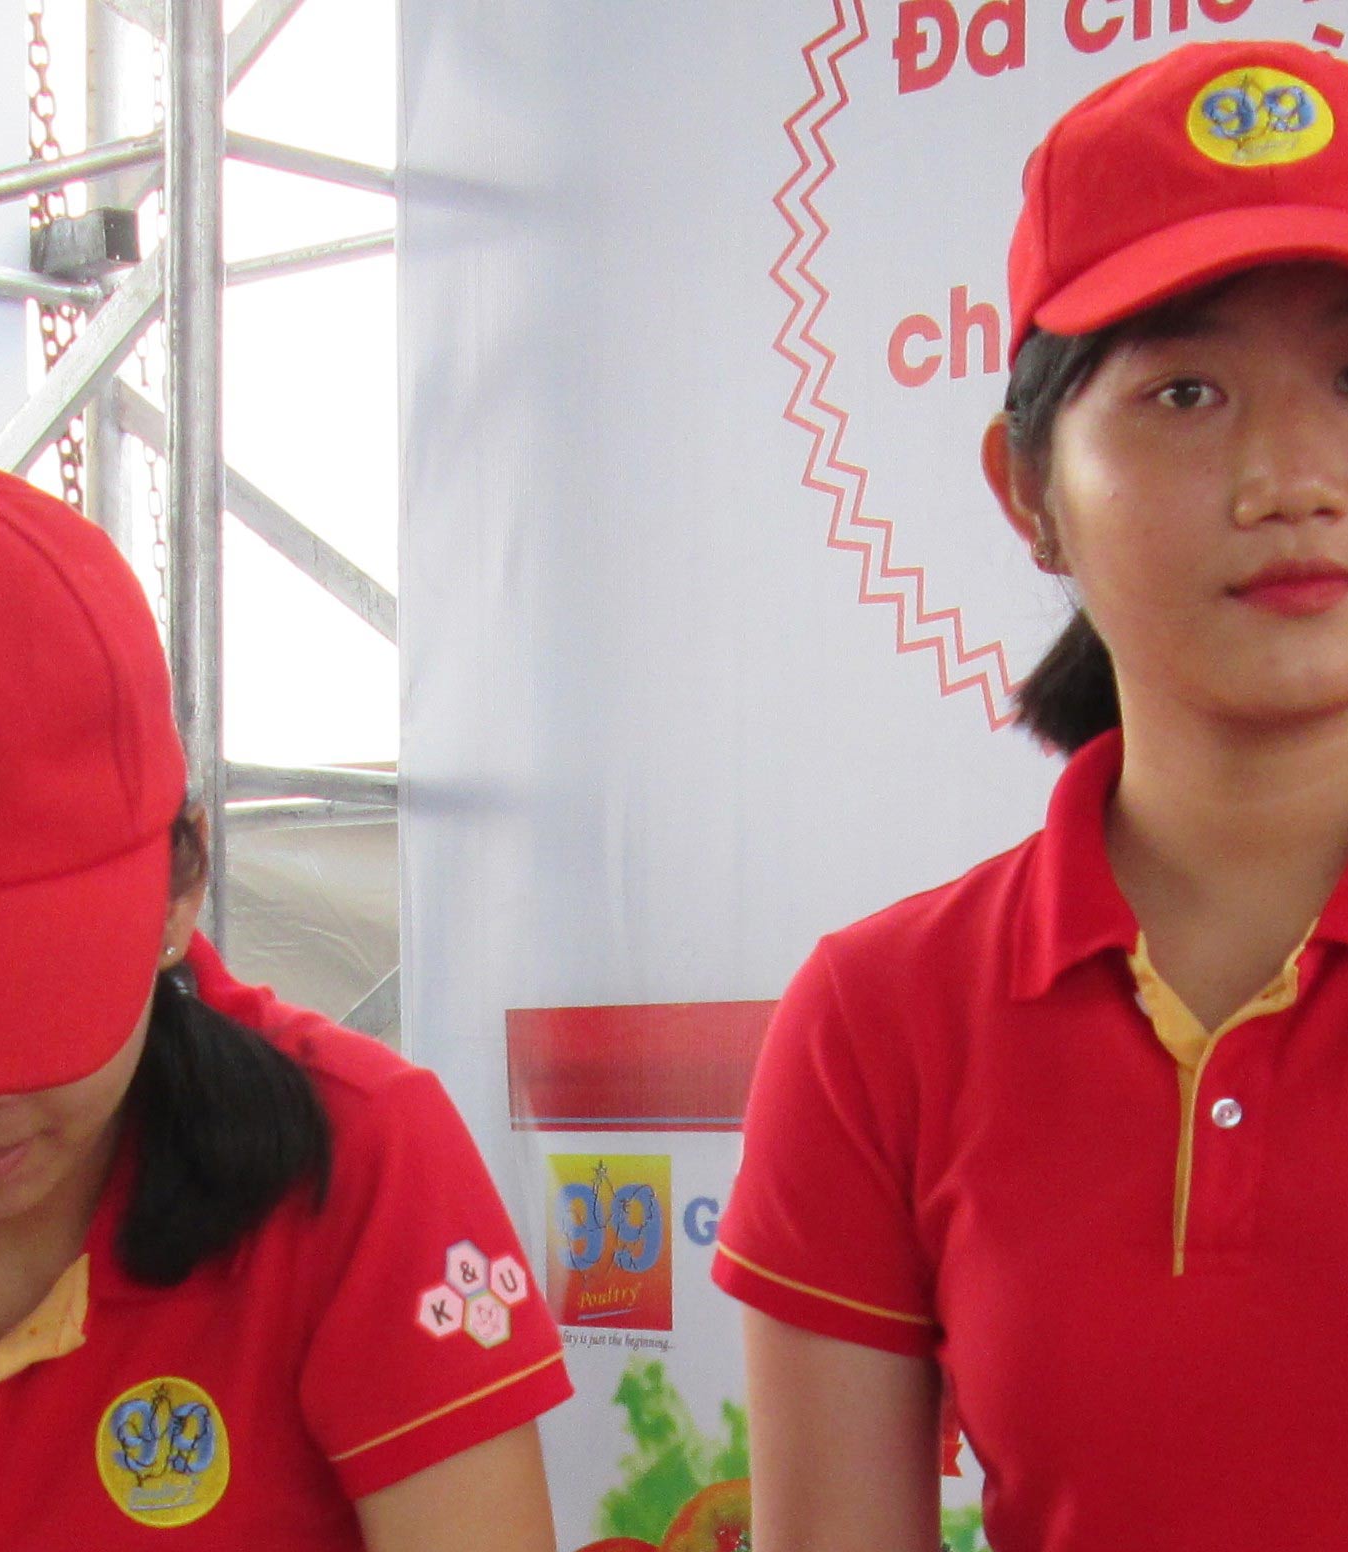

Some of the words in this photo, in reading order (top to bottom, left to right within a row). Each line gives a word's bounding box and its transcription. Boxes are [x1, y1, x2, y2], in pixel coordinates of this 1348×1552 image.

[1202, 84, 1318, 141] 99
[557, 1182, 664, 1274] 99
[110, 1397, 216, 1473] 99
